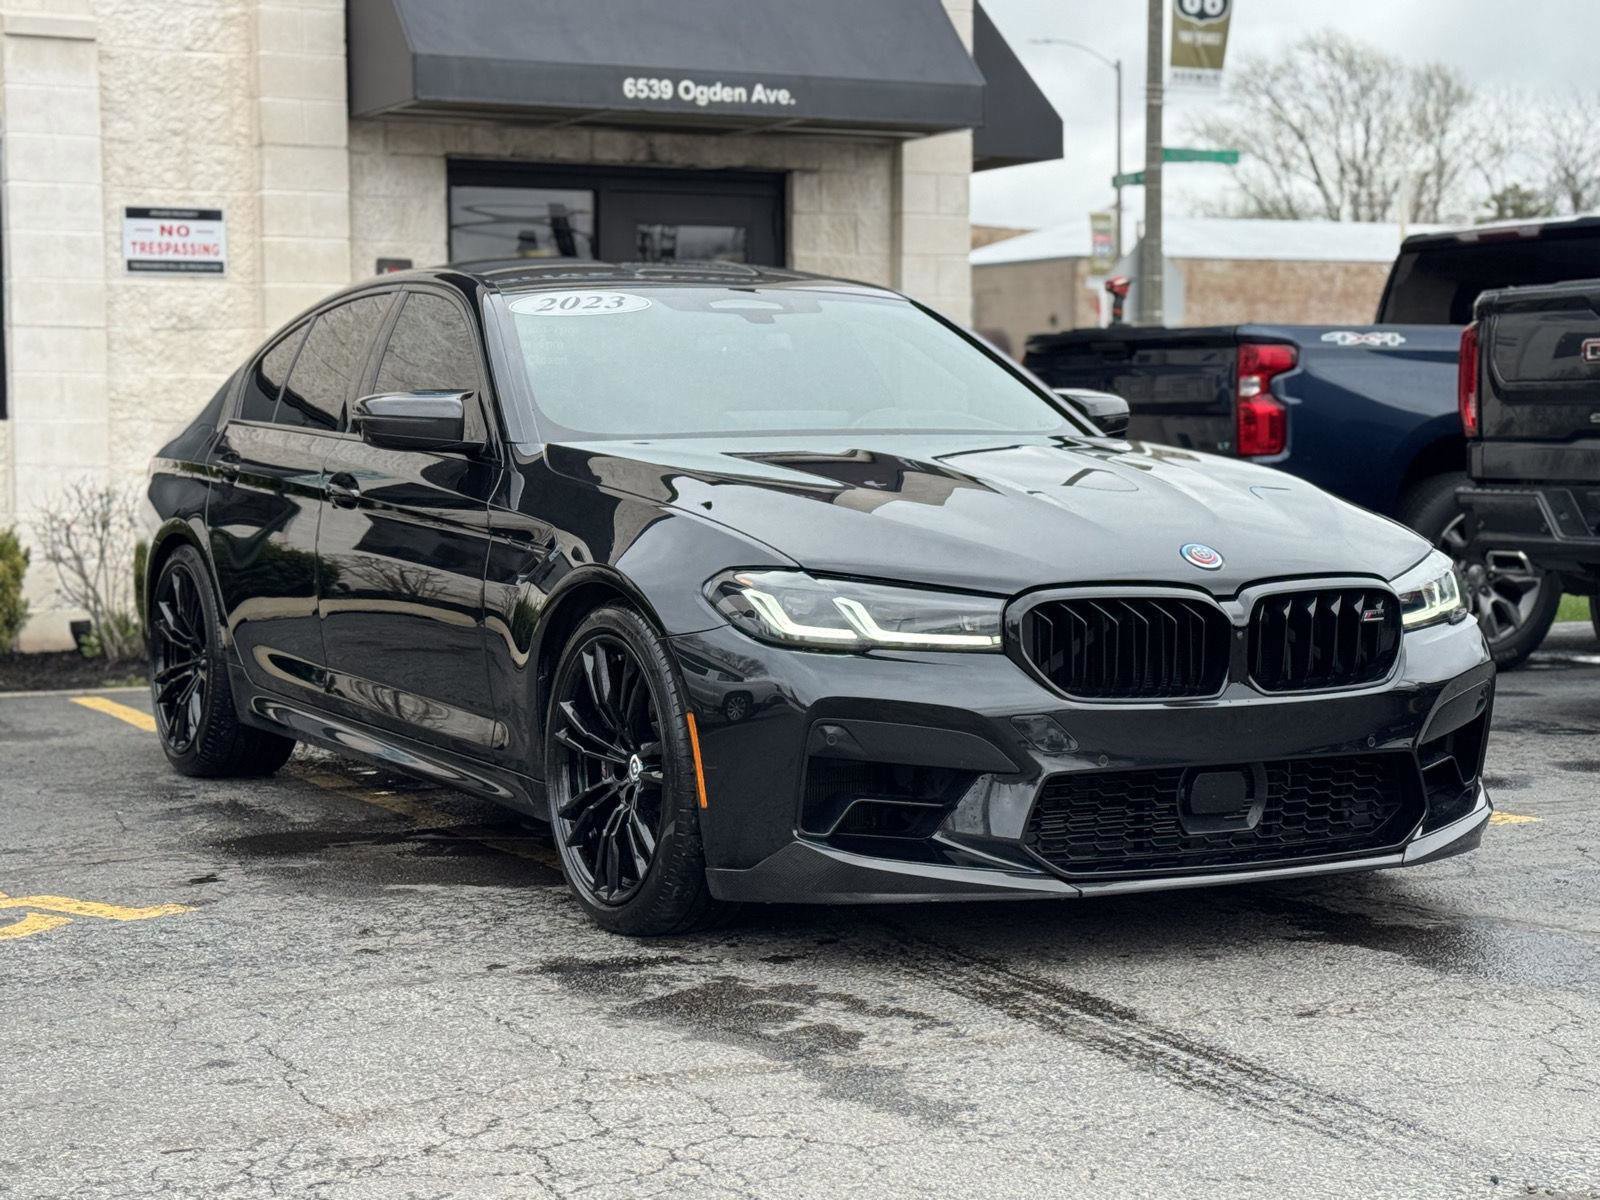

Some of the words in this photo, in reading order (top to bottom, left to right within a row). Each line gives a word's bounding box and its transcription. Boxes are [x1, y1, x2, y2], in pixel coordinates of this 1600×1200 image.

[623, 77, 673, 99] 6539
[678, 79, 747, 106] Ogden
[751, 83, 796, 105] Ave.
[160, 225, 190, 237] NO
[131, 241, 220, 256] TRESPASSING
[535, 296, 626, 312] 2023
